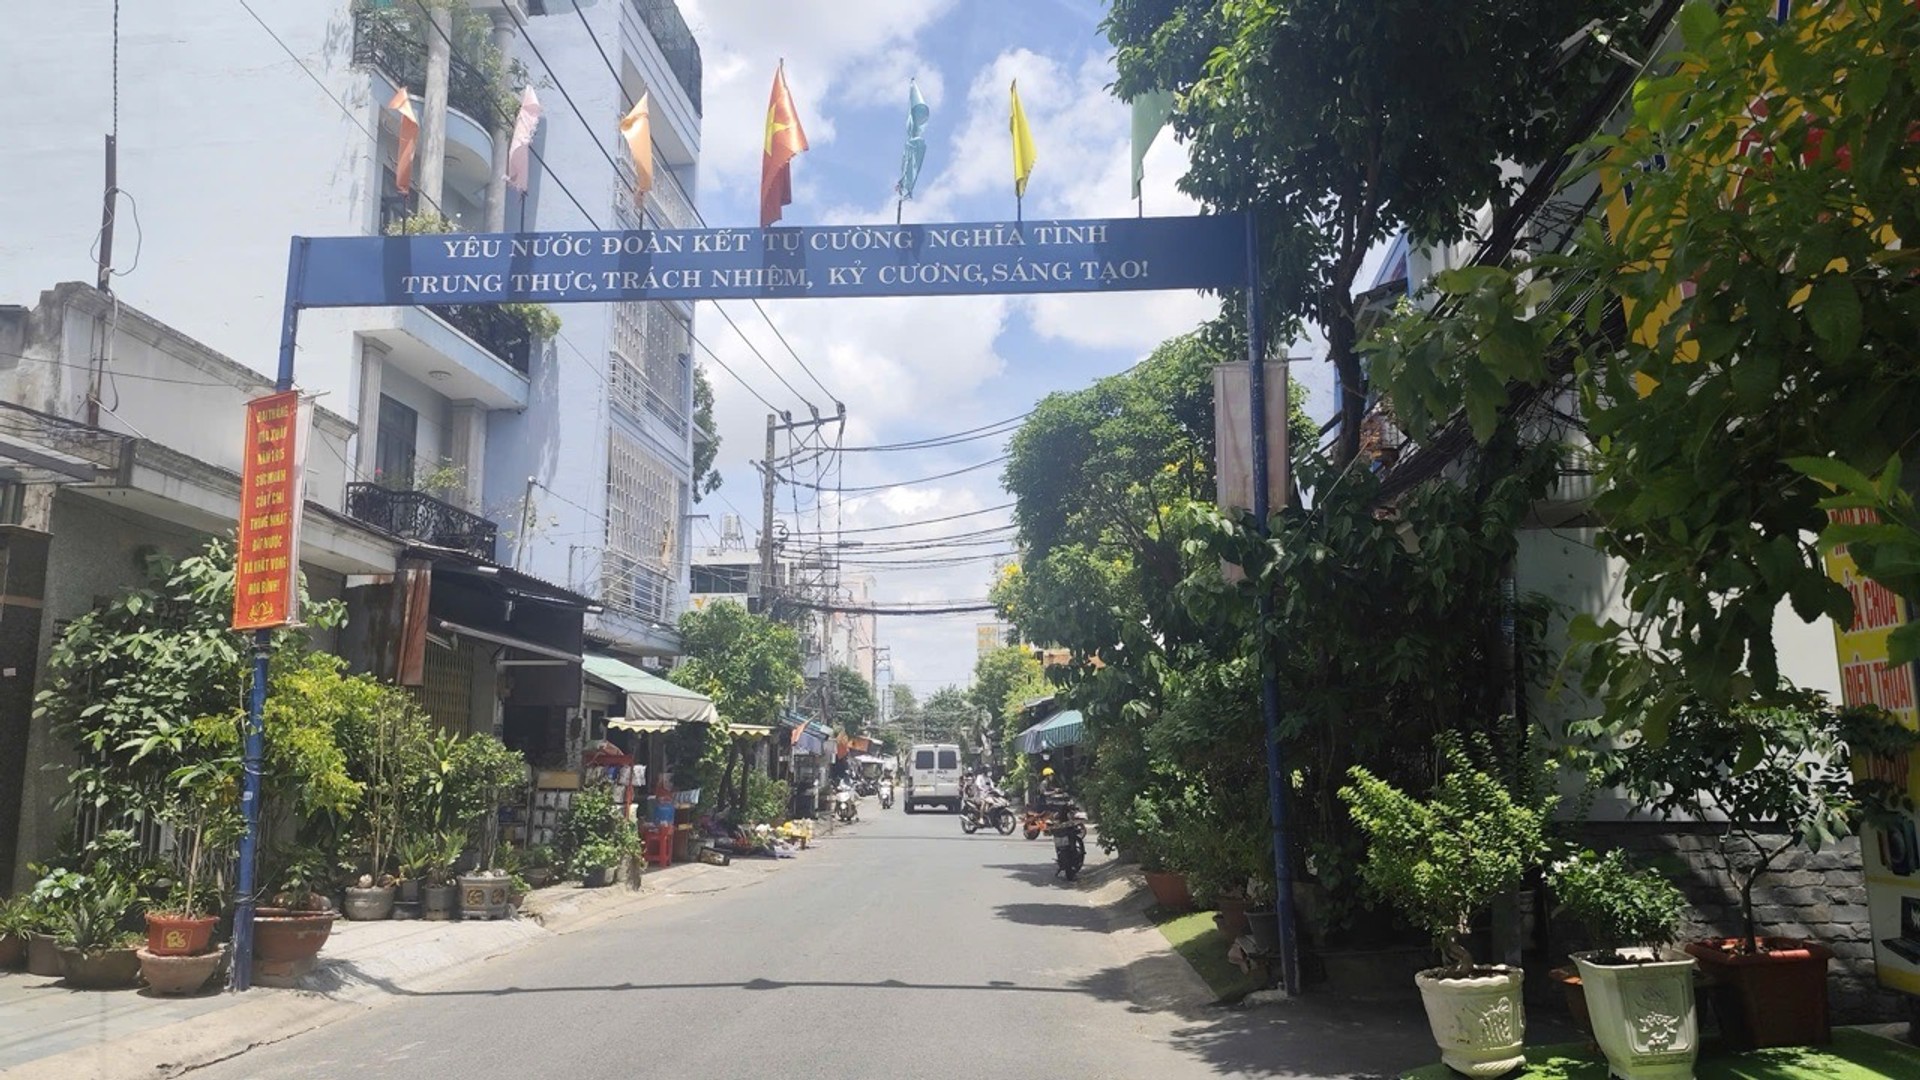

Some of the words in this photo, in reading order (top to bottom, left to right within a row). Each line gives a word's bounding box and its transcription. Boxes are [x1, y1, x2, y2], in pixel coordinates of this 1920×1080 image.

[443, 236, 502, 258] YÊU
[509, 233, 592, 258] NƯỚC
[602, 231, 683, 255] ĐOÀN
[692, 229, 752, 253] KẾT
[810, 227, 913, 251] CƯỜNG
[928, 223, 1026, 248] NGHĨA
[1034, 221, 1109, 245] TÌNH
[402, 274, 503, 295] TRUNG
[511, 271, 597, 296] THỰC,
[602, 266, 702, 290] TRÁCH
[710, 264, 813, 291] NHIỆM,
[828, 260, 869, 286] KỶ
[991, 257, 1073, 283] SÁNG
[1080, 260, 1149, 285] TẠO!
